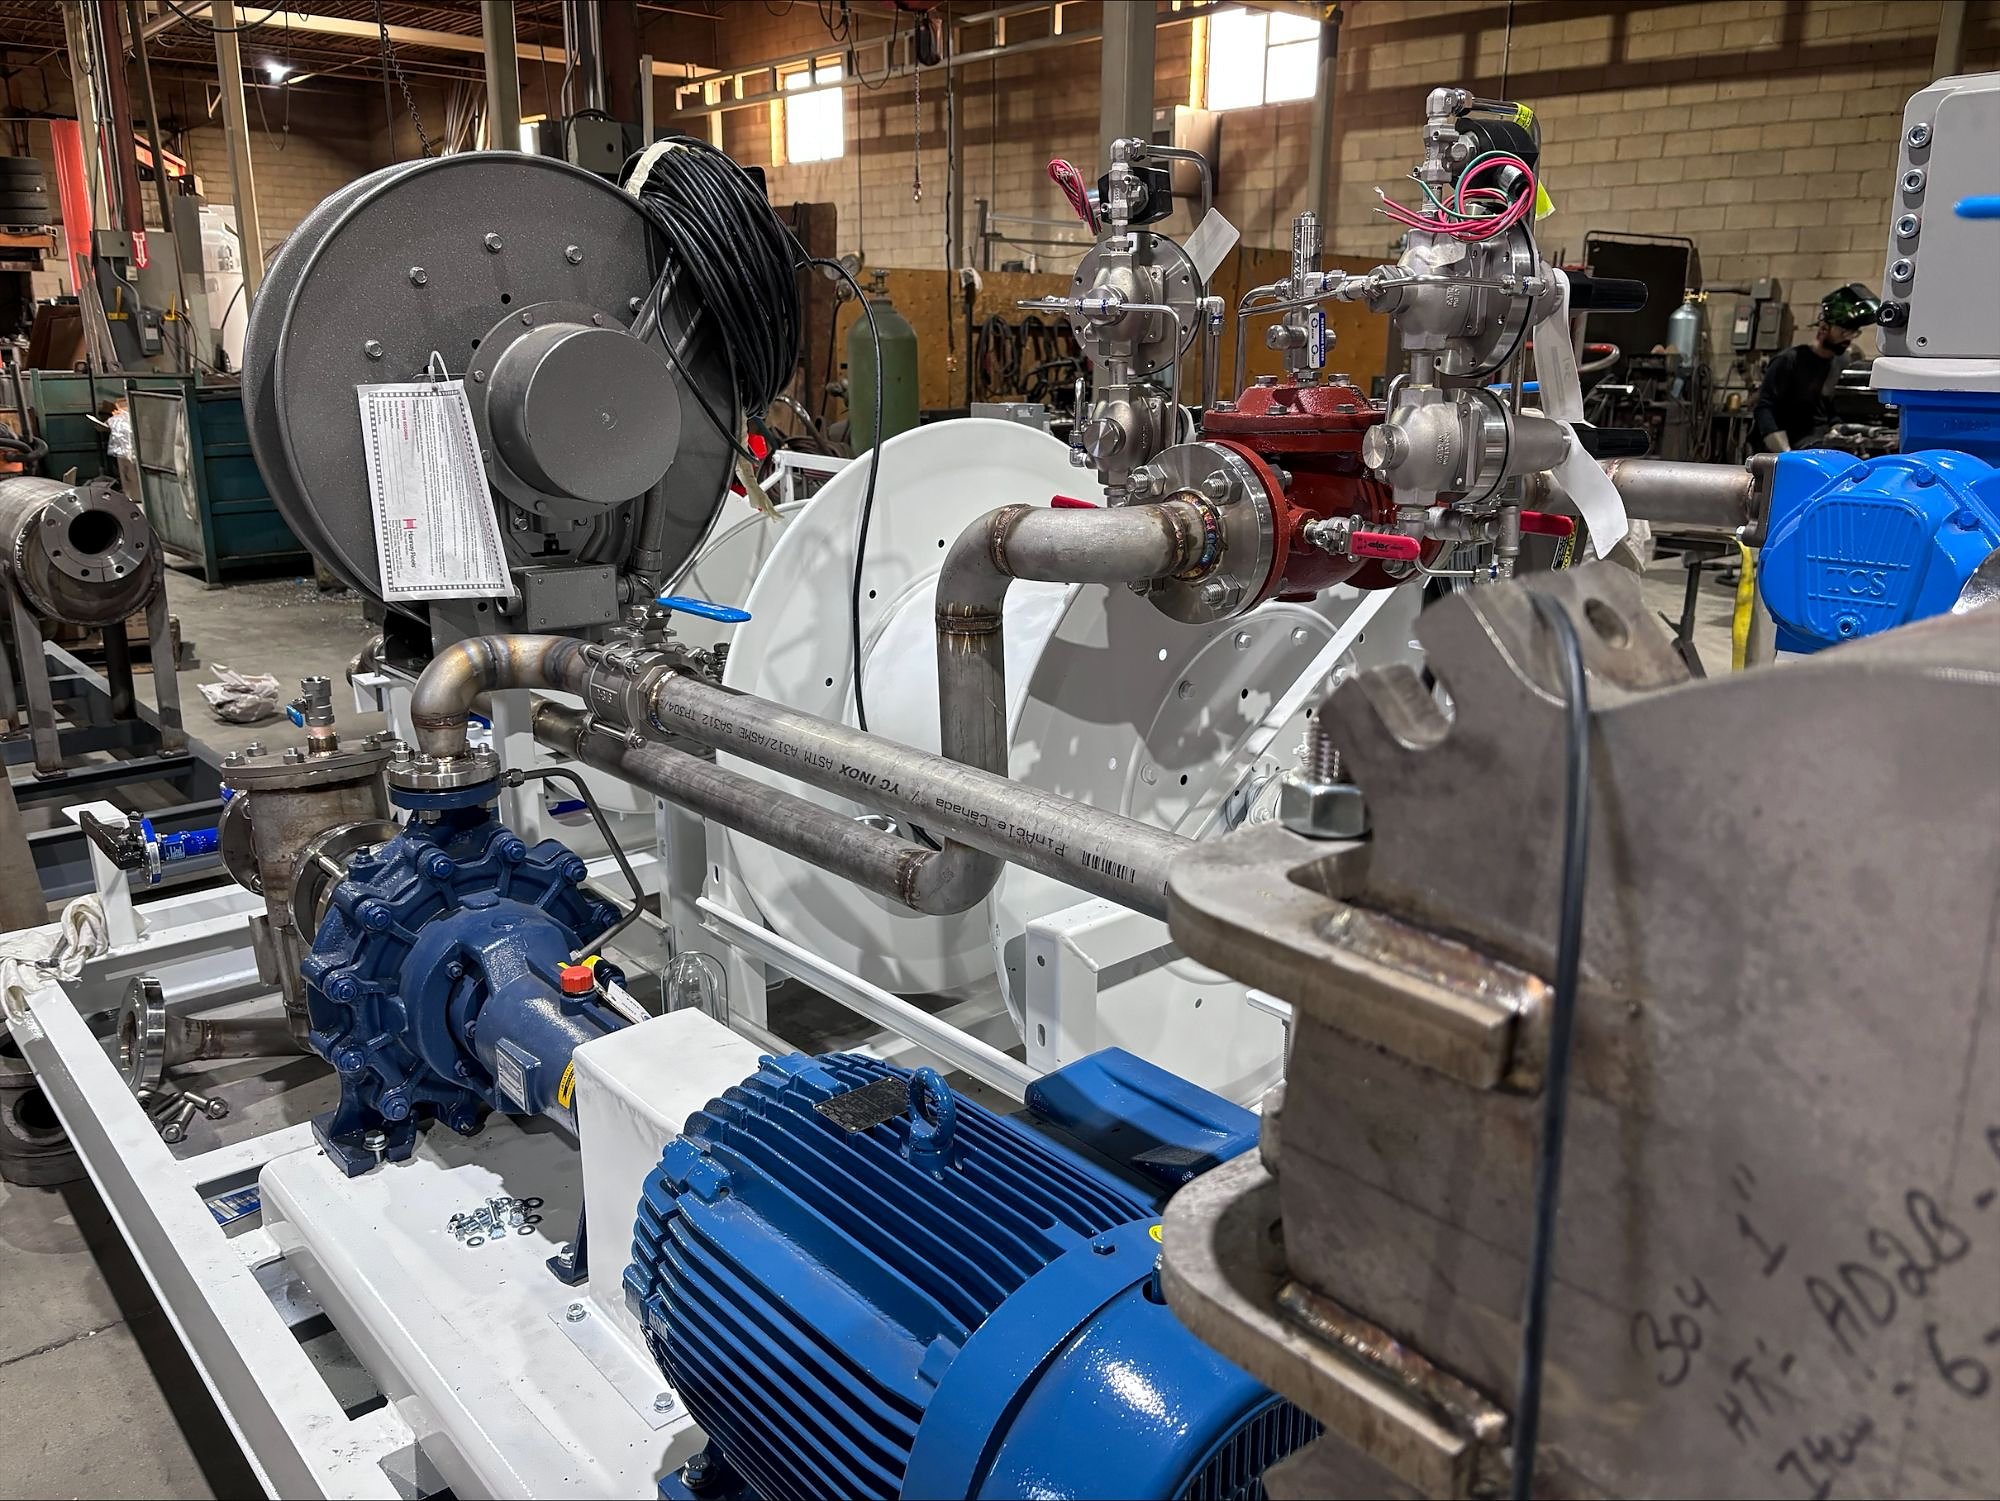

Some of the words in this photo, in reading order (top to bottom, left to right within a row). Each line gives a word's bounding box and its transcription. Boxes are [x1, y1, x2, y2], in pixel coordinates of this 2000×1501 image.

[406, 530, 416, 551] Hannay
[1826, 566, 1888, 597] TCS
[702, 714, 733, 734] SA312
[738, 727, 798, 758] A312/ASME
[803, 751, 834, 770] ASTM
[838, 763, 877, 786] INOX
[879, 778, 900, 794] YC
[935, 798, 988, 828] Canada
[1630, 1275, 1722, 1388] 304
